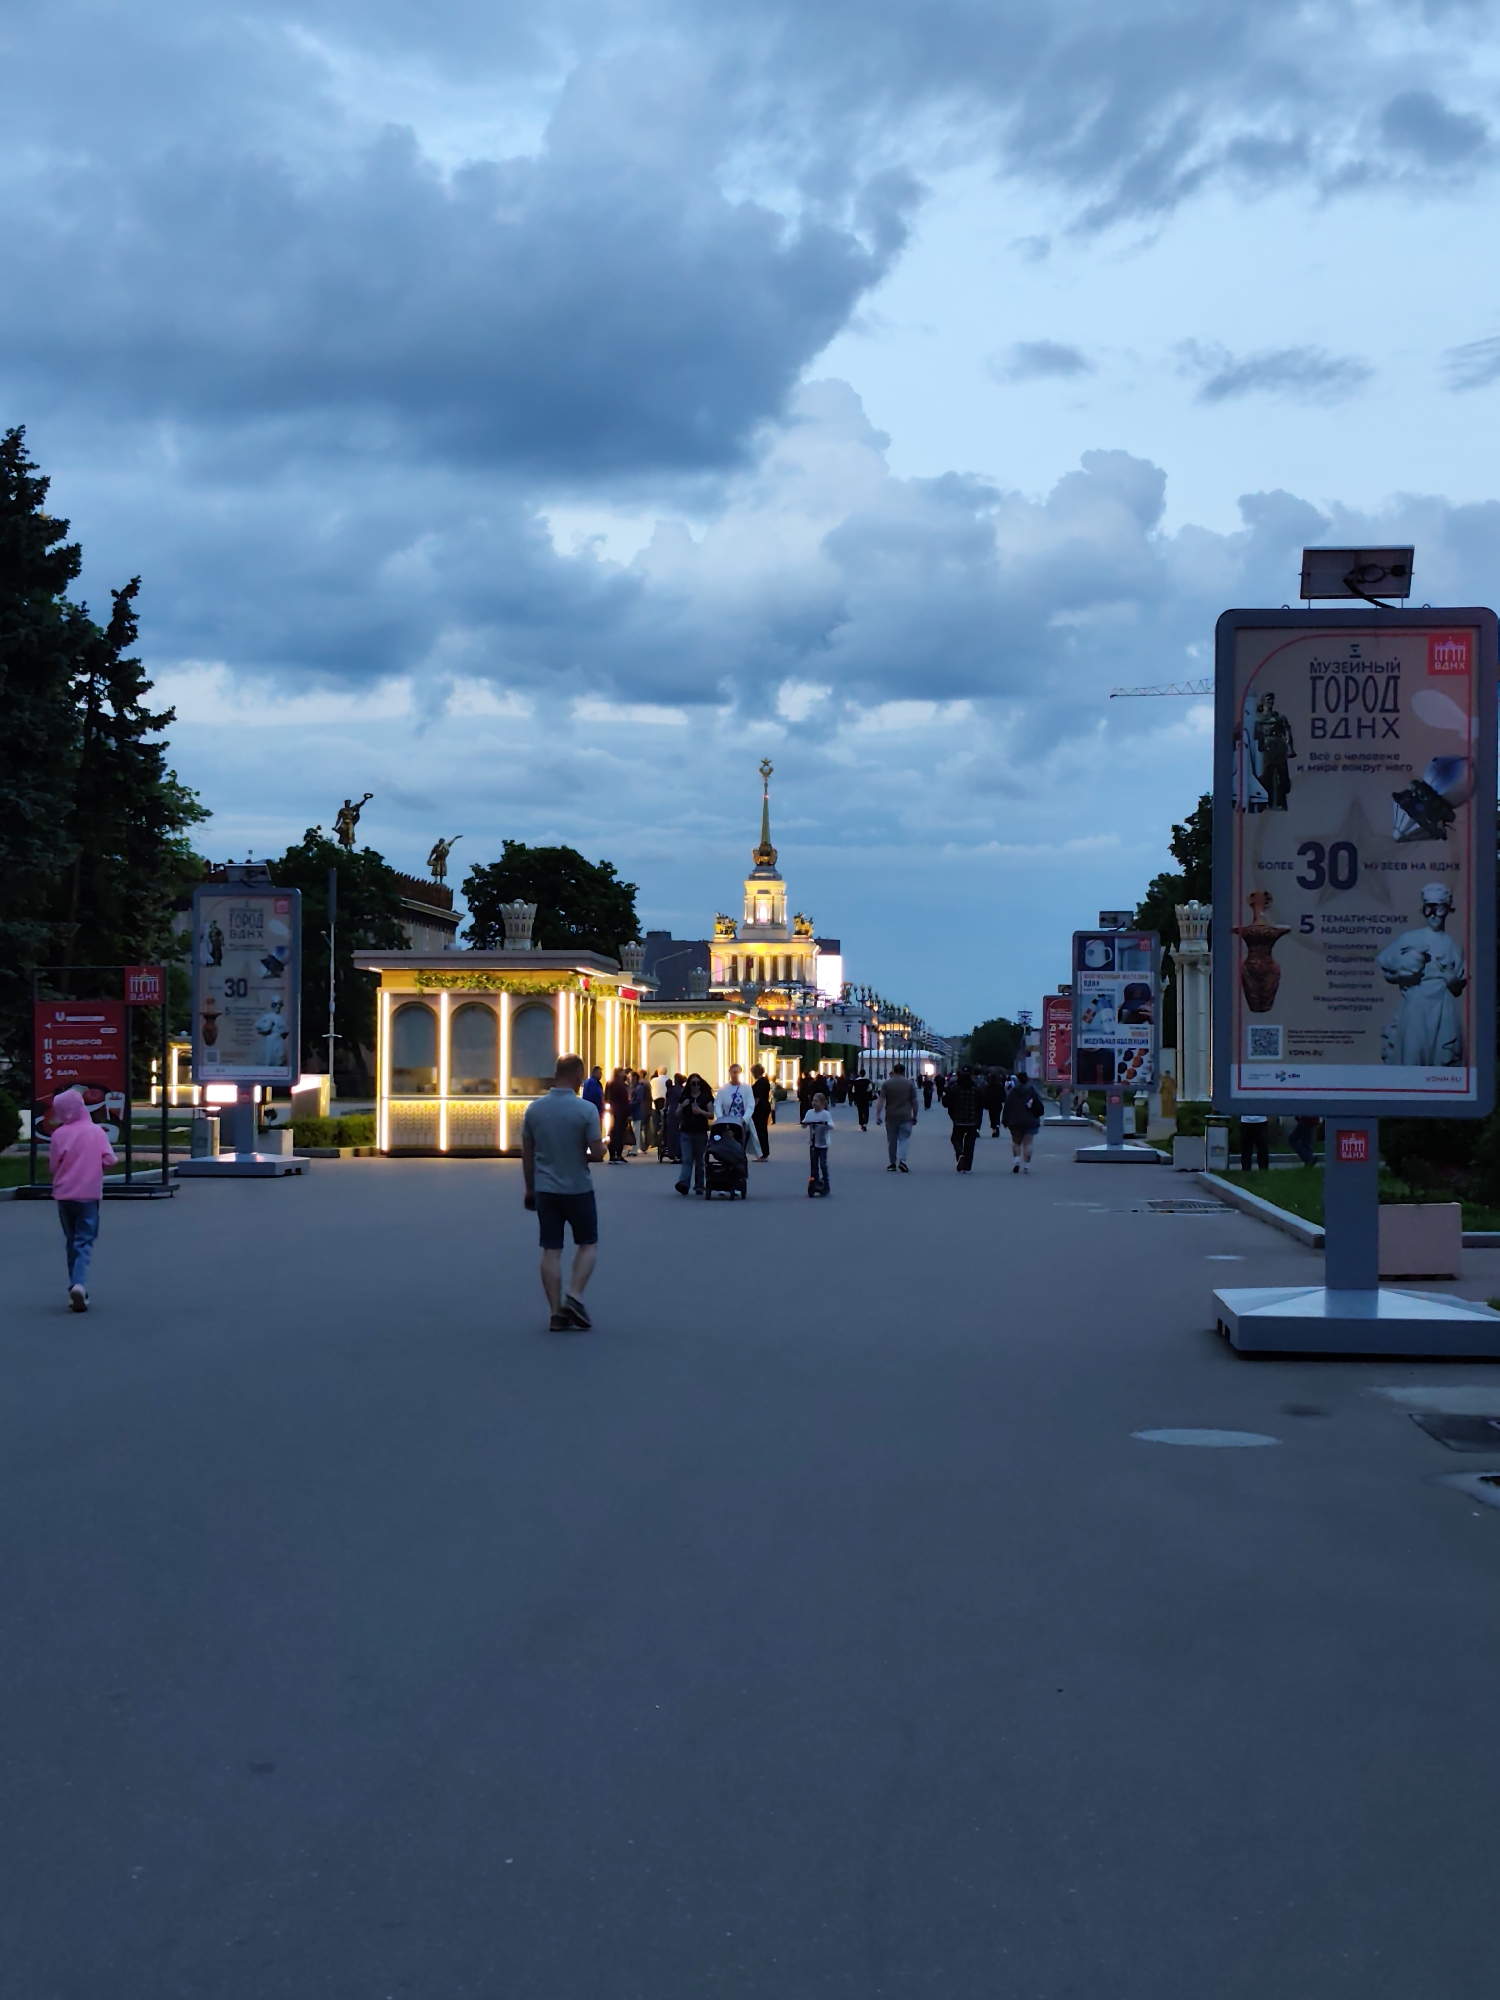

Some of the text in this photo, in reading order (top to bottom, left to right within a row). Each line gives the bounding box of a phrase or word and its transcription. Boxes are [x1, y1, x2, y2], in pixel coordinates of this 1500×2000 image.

[1310, 658, 1400, 674] МУЗЕЙНЫЙ
[1434, 661, 1466, 671] ВДНХ
[1310, 675, 1400, 713] ГОРОД
[1310, 717, 1400, 739] ВДНХ
[1310, 752, 1400, 761] Всё о человеке
[1308, 764, 1338, 773] мире
[1342, 764, 1381, 773] вокруг
[1258, 841, 1460, 890] БОЛЕЕ 30 МУЗЕЕВ НА ВДНХ
[229, 913, 264, 929] ГОРОД
[1299, 914, 1409, 935] 5 ТЕМАТИЧЕСКИХ
[229, 929, 264, 939] ВДНХ
[1321, 926, 1392, 935] МАРШРУТОВ
[1323, 942, 1378, 950] Технологии
[1326, 955, 1375, 963] Общество
[1325, 969, 1375, 977] Искусство
[224, 977, 248, 998] 30
[130, 993, 159, 1001] ВДНХ
[225, 1006, 231, 1016] 5
[44, 1038, 53, 1050] 11
[1049, 1023, 1057, 1065] РОБОТЫ
[1288, 1049, 1324, 1057] VDNH.RU
[44, 1052, 53, 1065] 8
[44, 1067, 53, 1080] 2
[1341, 1151, 1365, 1159] ВДНХ
